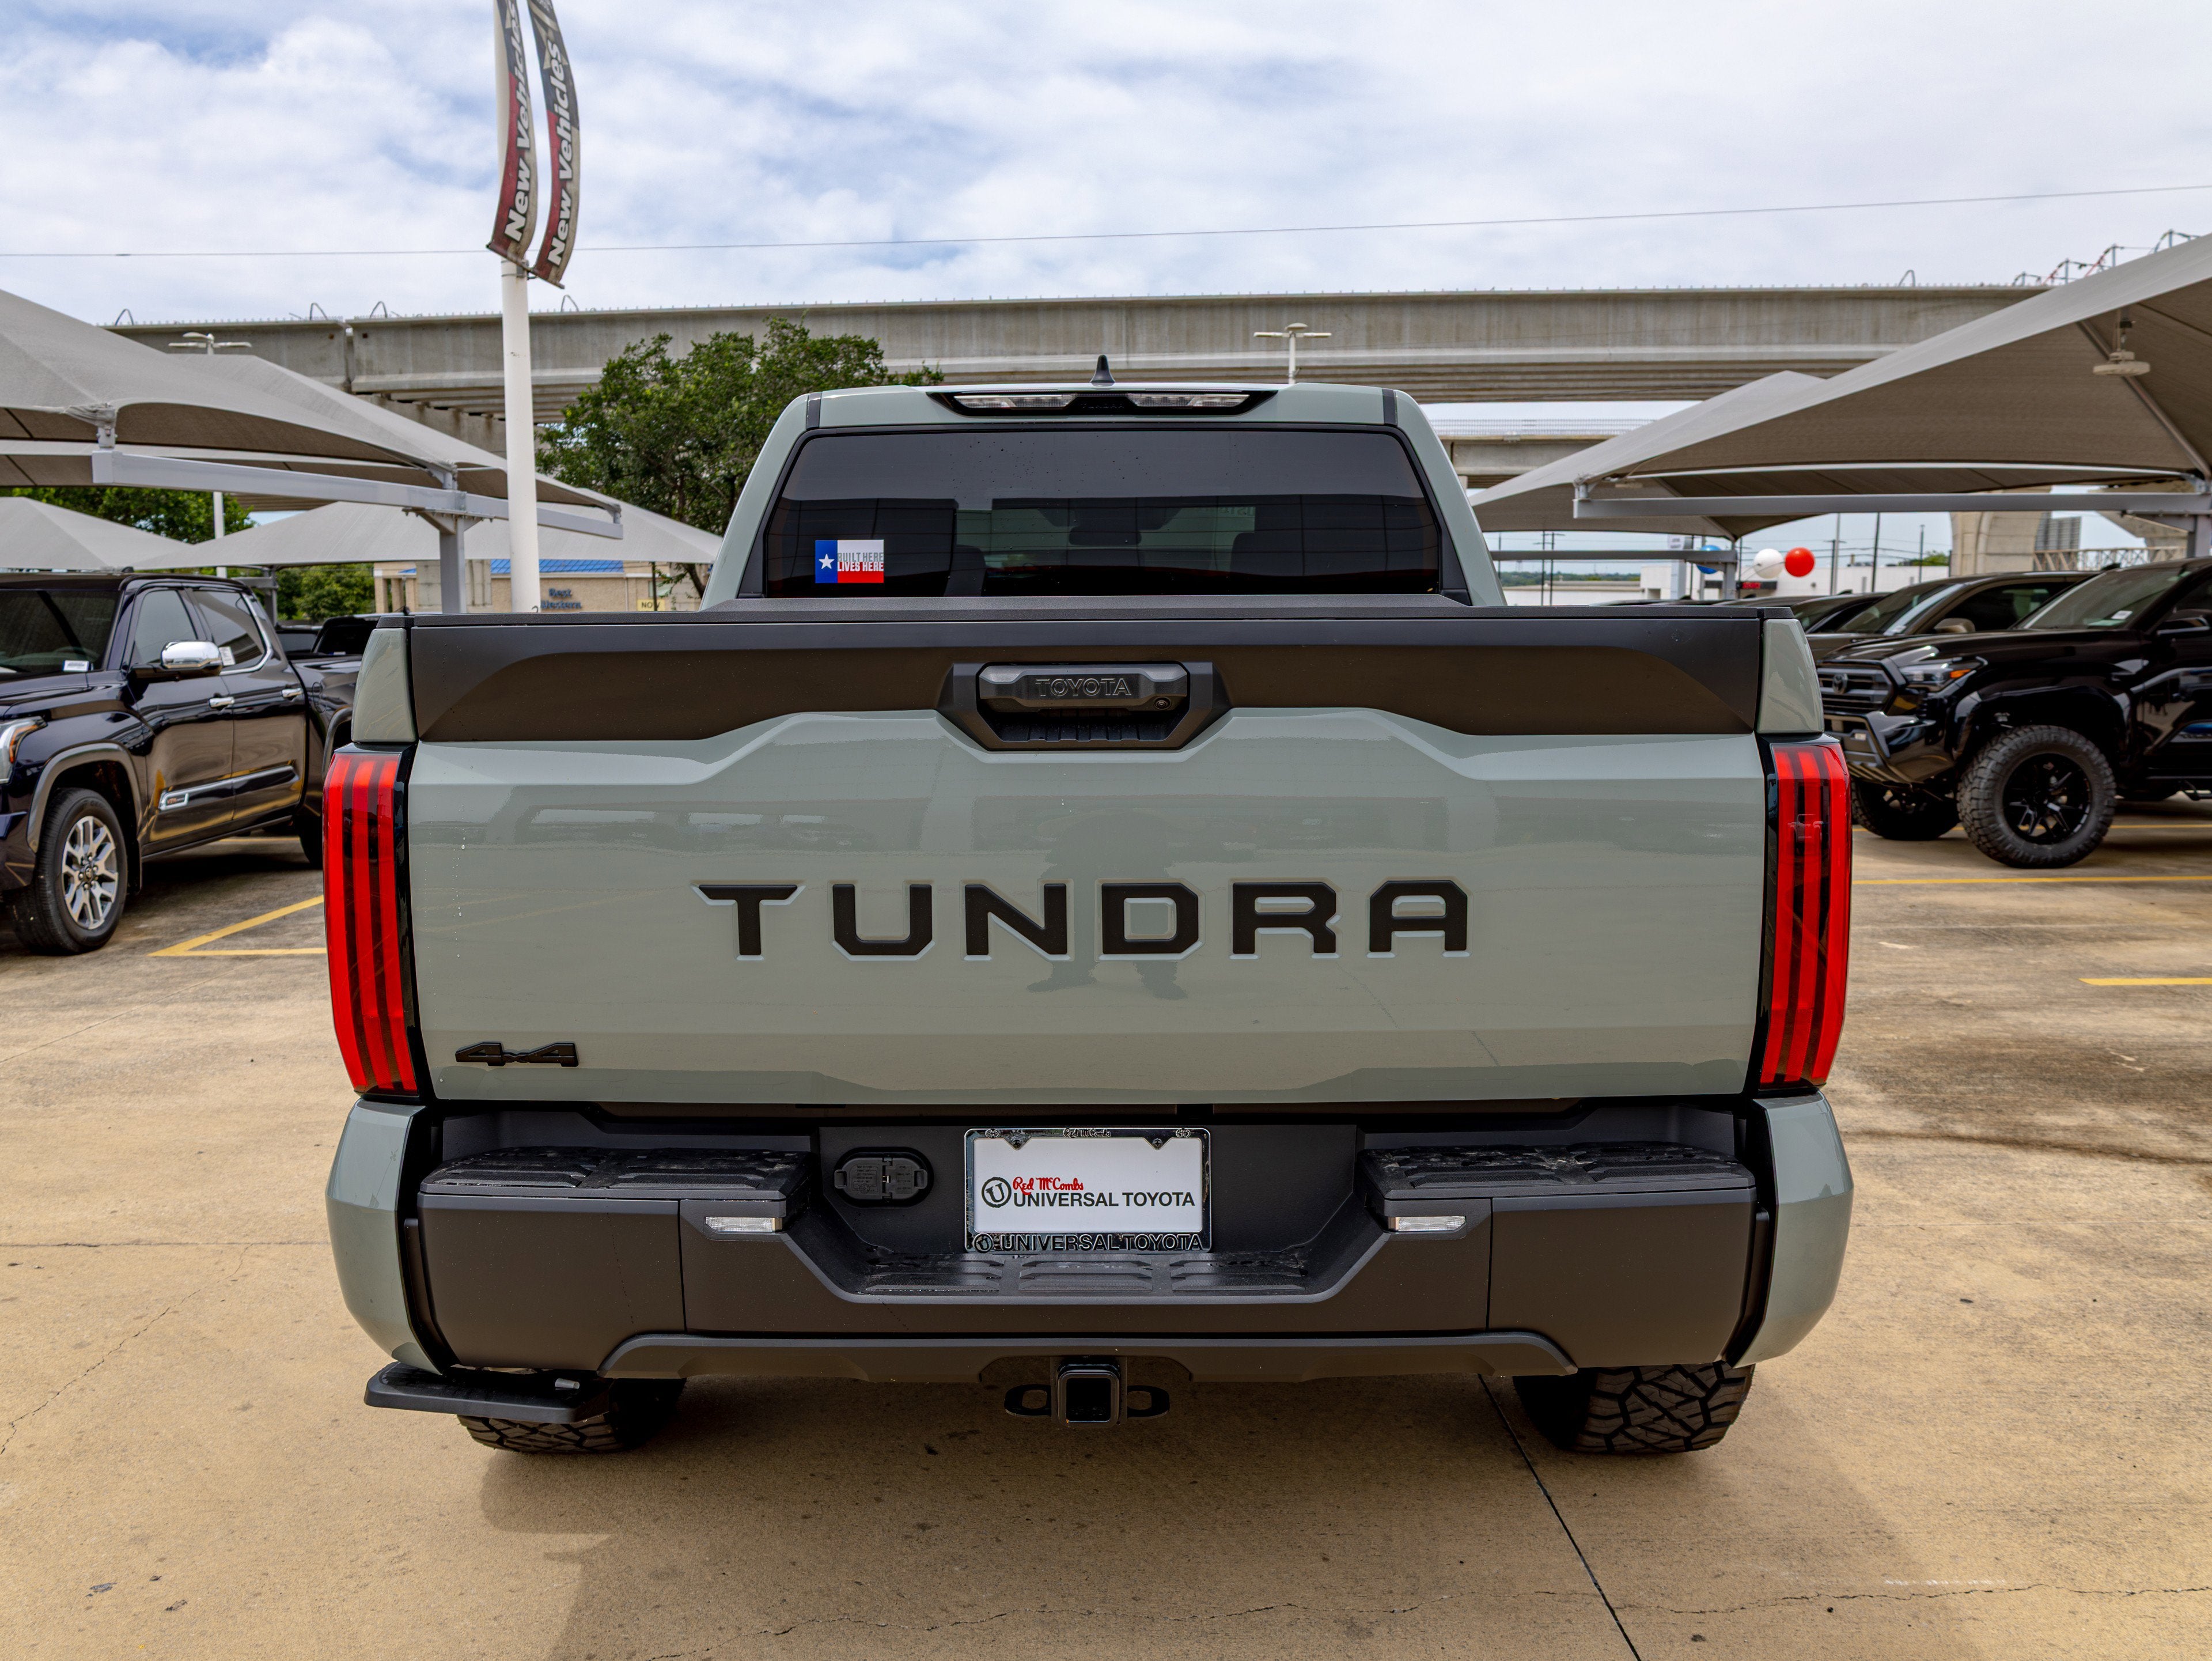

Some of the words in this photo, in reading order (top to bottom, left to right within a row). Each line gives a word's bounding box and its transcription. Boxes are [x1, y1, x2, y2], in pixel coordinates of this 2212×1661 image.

[508, 0, 530, 150] Vehicles
[548, 39, 573, 180] Vehicles
[505, 157, 531, 242] New
[548, 188, 572, 266] New
[838, 553, 861, 562] BUILT
[863, 553, 884, 562] HERE
[838, 562, 861, 572] LIVES
[862, 562, 884, 572] HERE
[549, 588, 571, 598] Best
[1035, 678, 1132, 697] TOYOTA
[692, 879, 1470, 962] TUNDRA
[1013, 1176, 1034, 1195] Red
[1013, 1192, 1119, 1206] UNIVERSAL
[1122, 1192, 1195, 1206] TOYOTA
[1001, 1234, 1120, 1251] UNIVERSAL
[1122, 1234, 1203, 1251] TOYOTA
